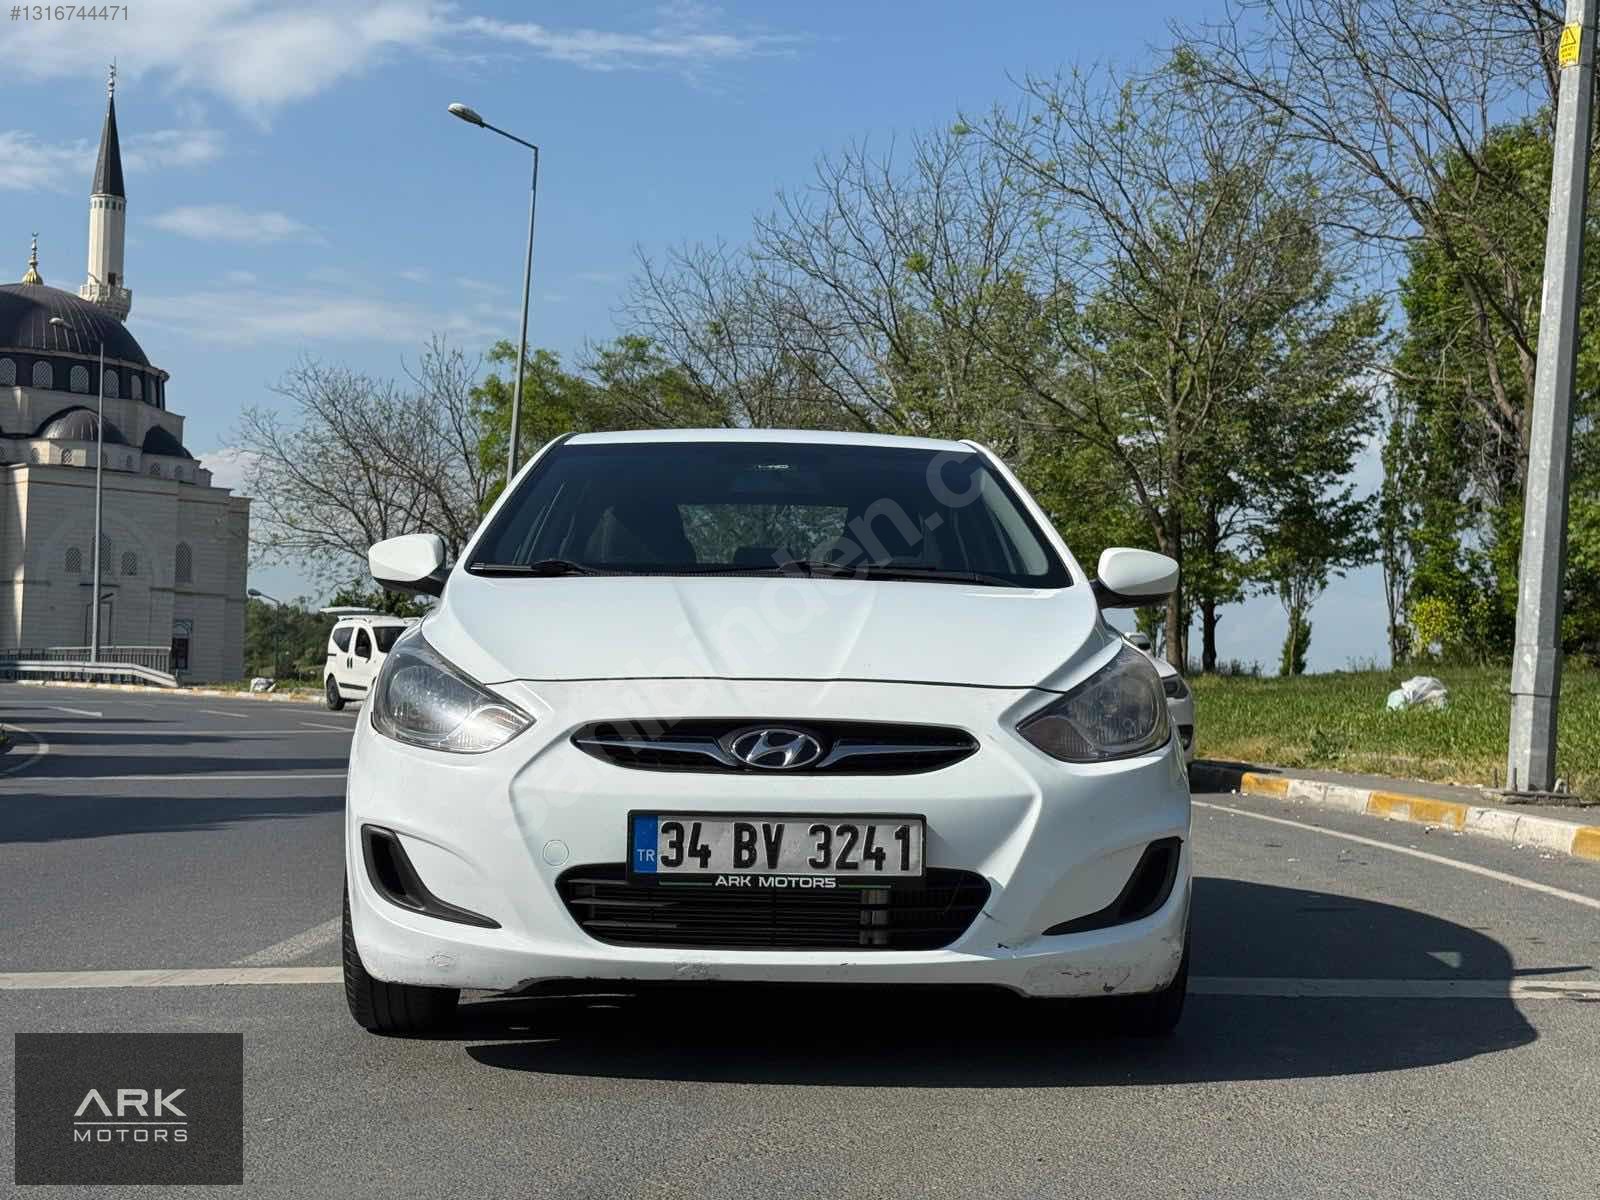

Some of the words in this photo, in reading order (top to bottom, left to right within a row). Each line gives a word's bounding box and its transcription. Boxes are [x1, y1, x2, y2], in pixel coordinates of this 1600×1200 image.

[660, 821, 711, 868] 34
[733, 822, 785, 869] BV
[807, 823, 911, 871] 3241
[637, 849, 655, 862] TR
[715, 874, 752, 887] ARK
[758, 875, 836, 888] MOTORS
